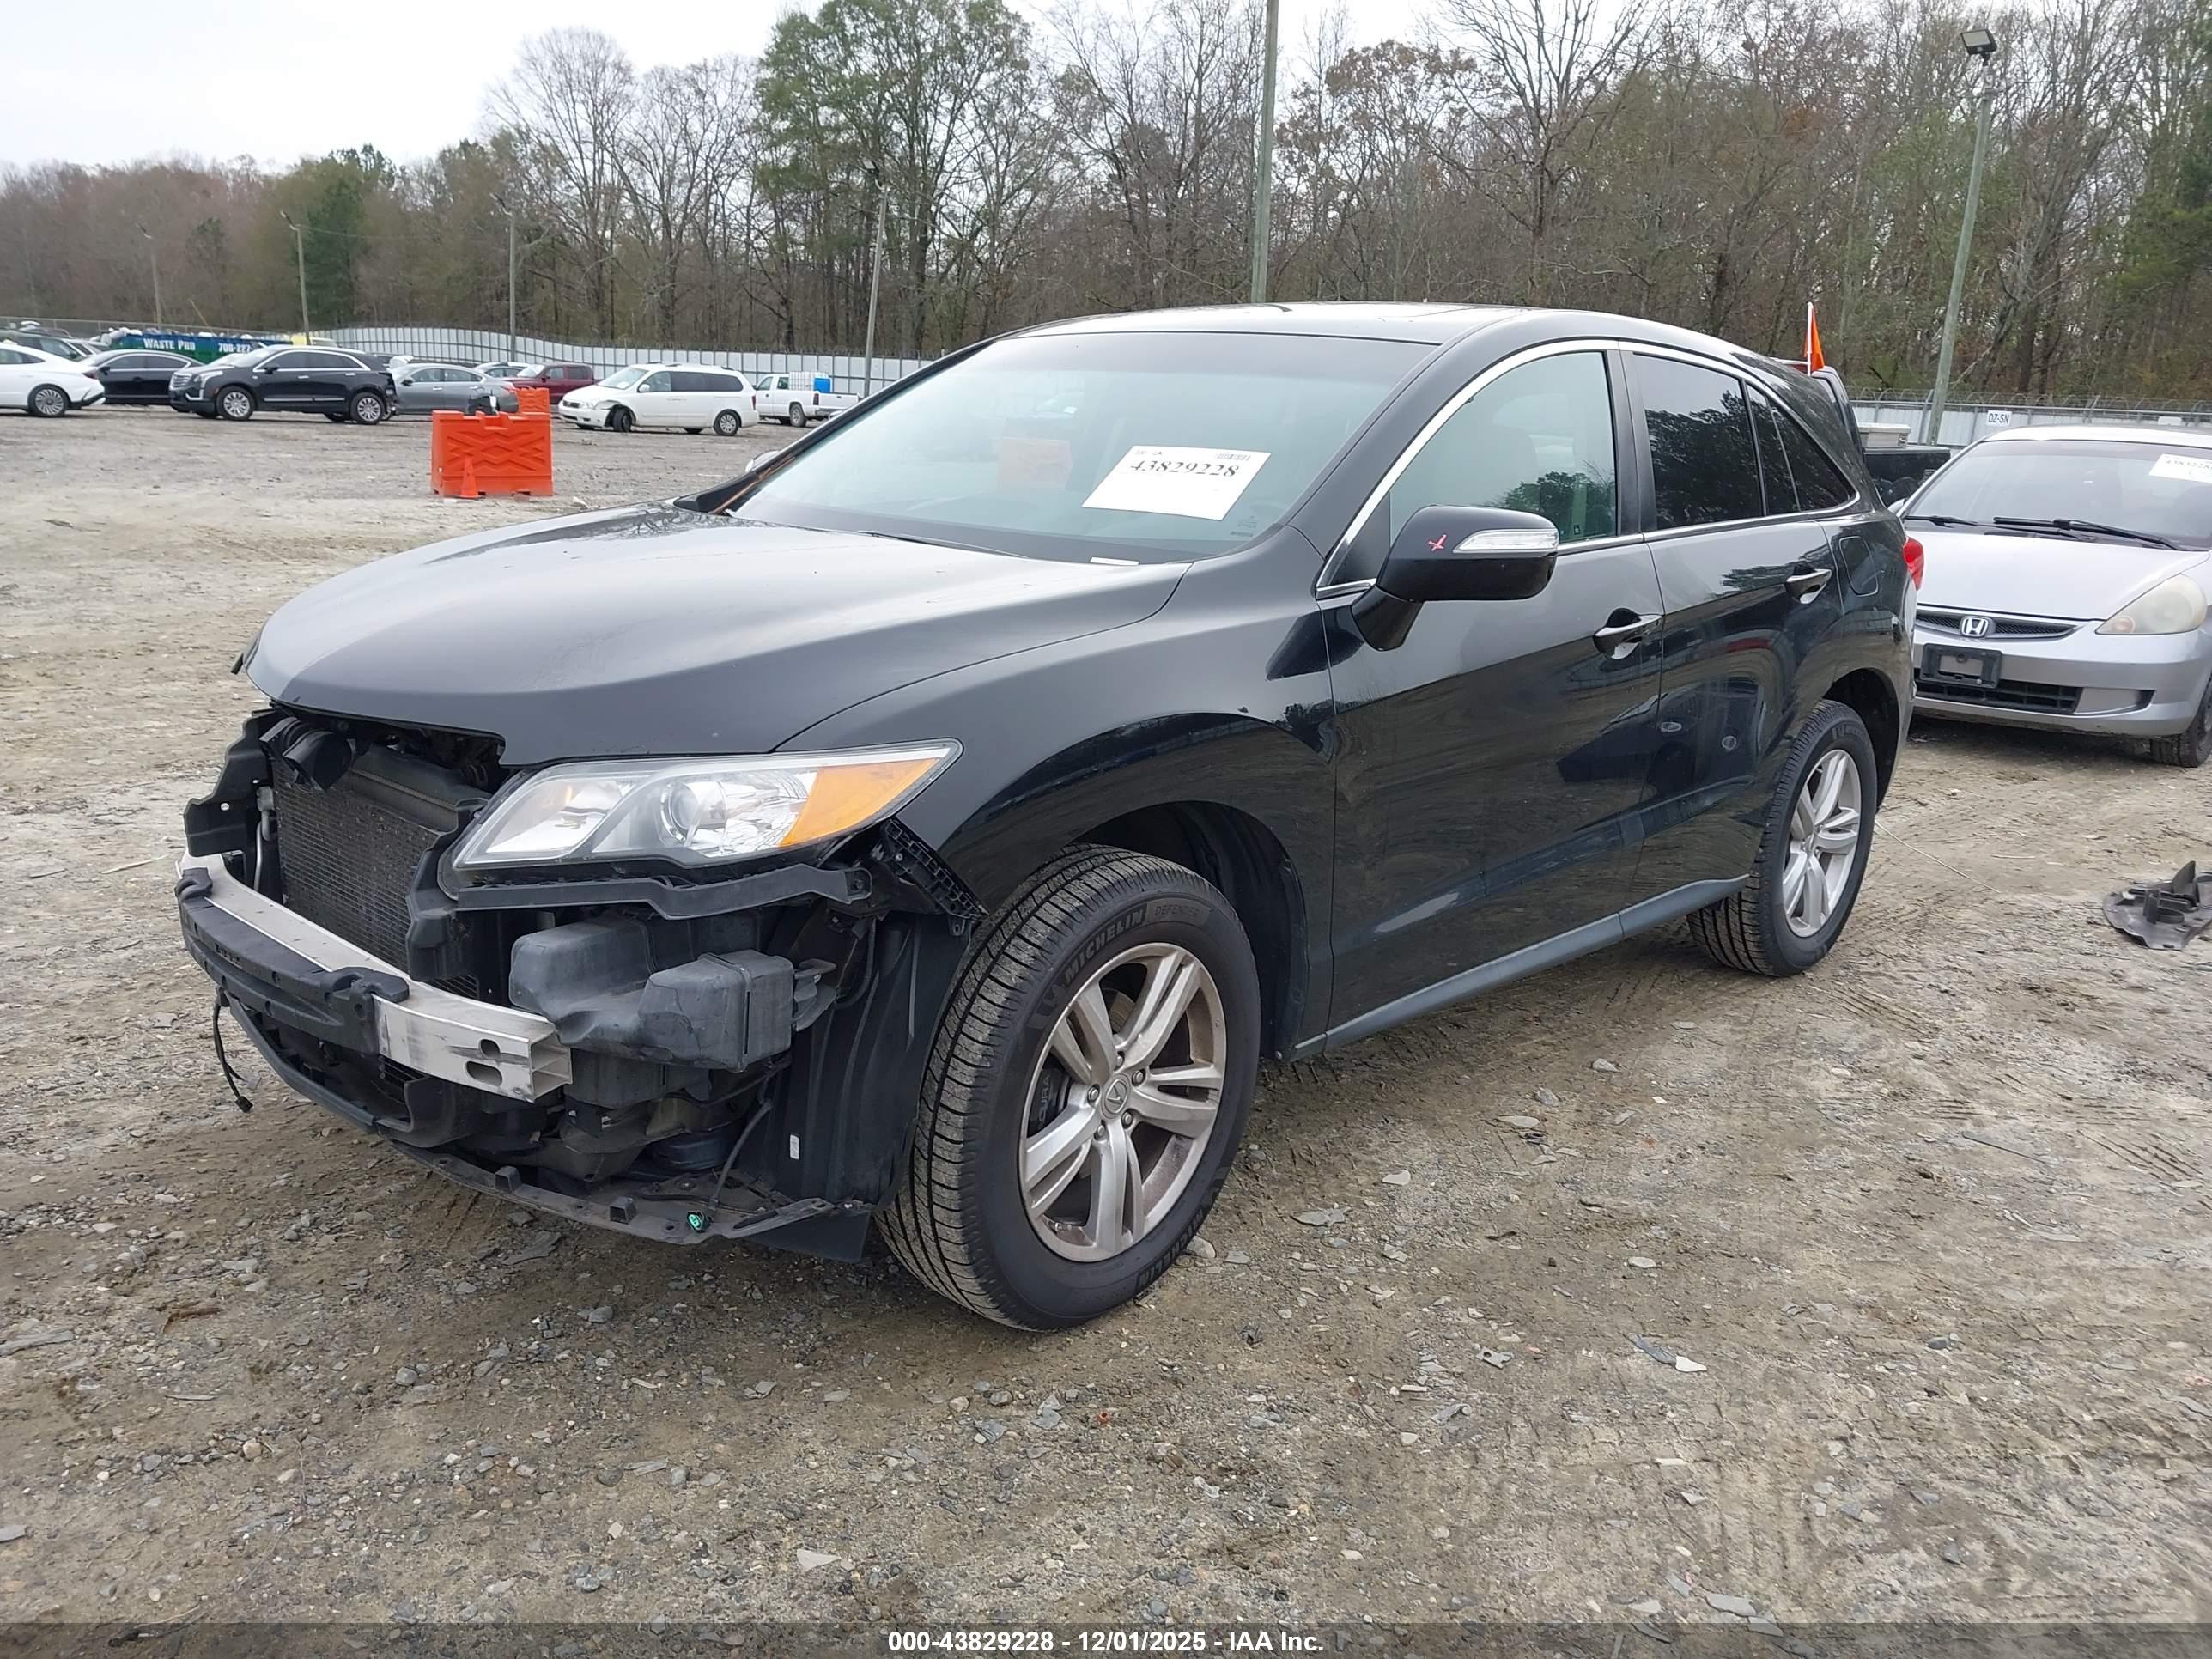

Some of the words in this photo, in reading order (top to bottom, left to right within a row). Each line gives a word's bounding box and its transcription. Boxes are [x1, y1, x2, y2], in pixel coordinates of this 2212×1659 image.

[143, 338, 175, 349] WASTE
[178, 340, 197, 351] PRO
[1988, 413, 2010, 424] DZ-SN
[1130, 459, 1240, 477] 43829228
[1064, 908, 1145, 986] MICHELIN
[1154, 904, 1200, 917] DEFENDER
